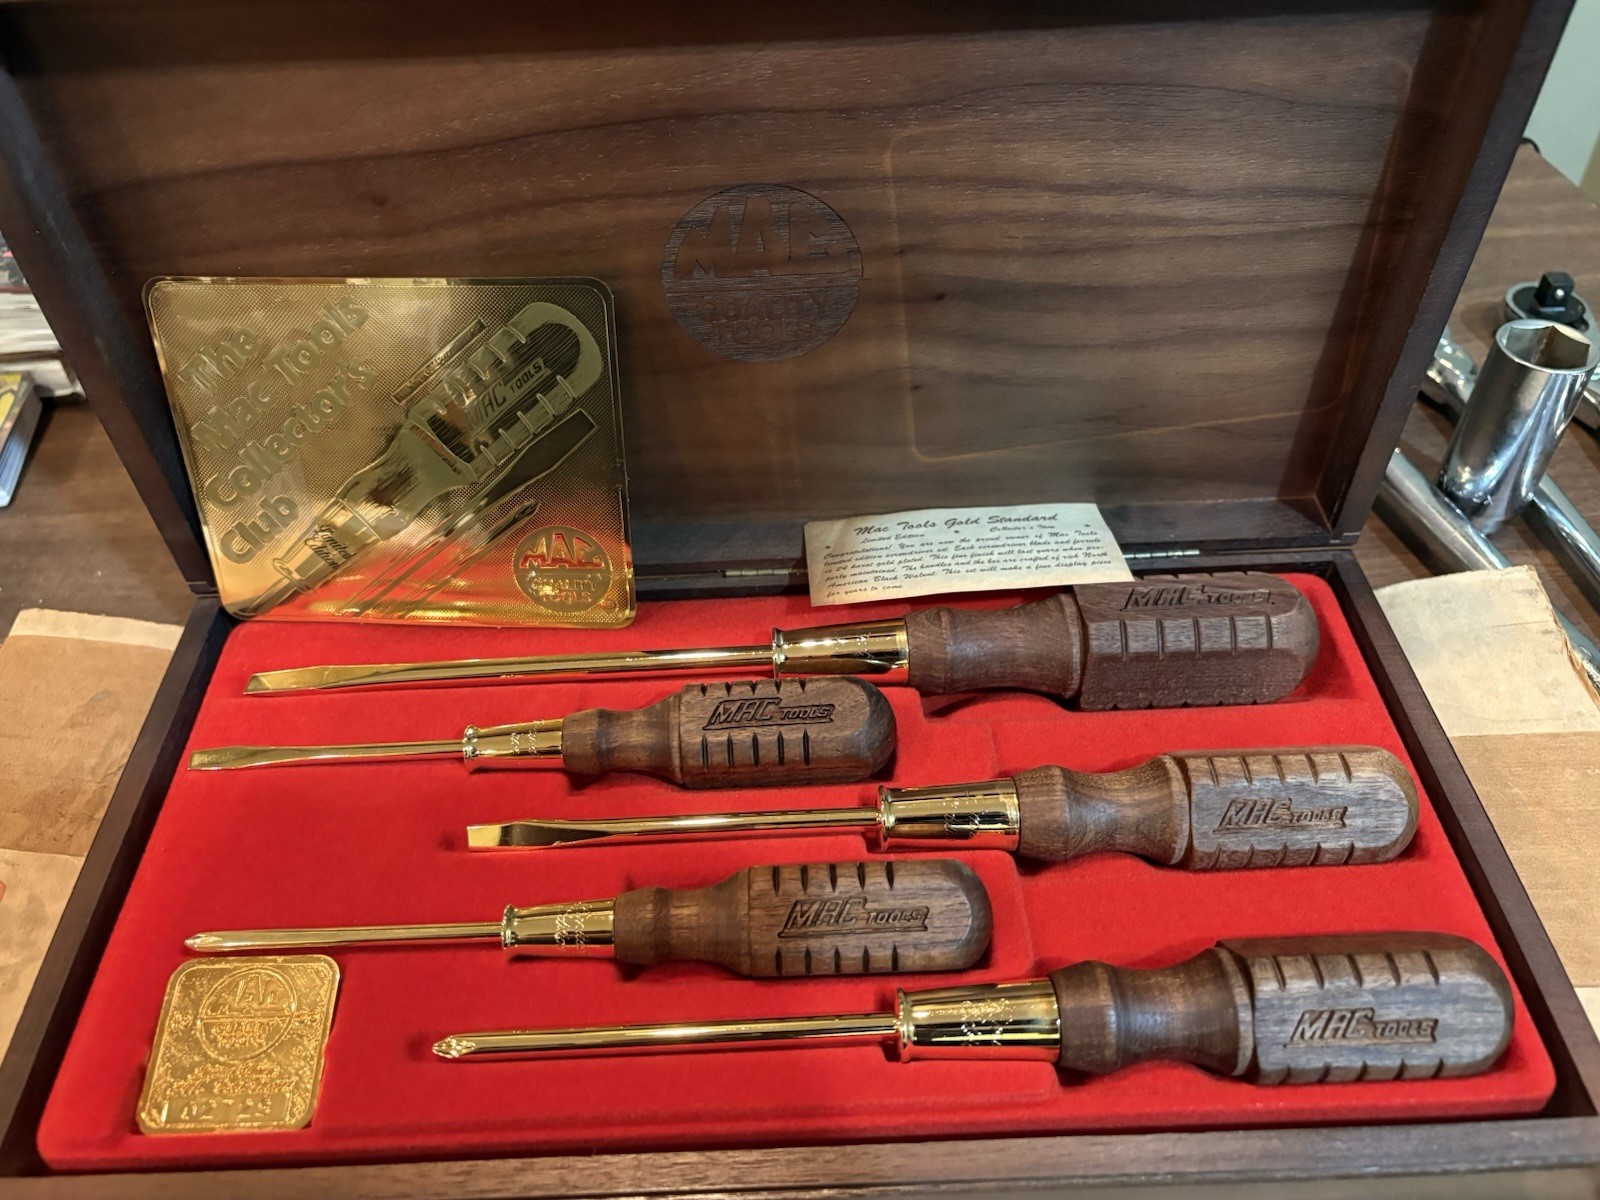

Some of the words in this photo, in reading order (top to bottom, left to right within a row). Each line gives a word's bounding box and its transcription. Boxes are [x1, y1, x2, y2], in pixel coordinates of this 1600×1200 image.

[673, 195, 852, 279] MAC
[178, 326, 260, 396] The
[191, 381, 280, 460] Mac
[262, 295, 370, 387] Tools
[510, 361, 543, 394] TOOLS
[204, 359, 377, 512] Collector's
[220, 495, 300, 565] Club
[854, 525, 890, 535] Mac
[896, 519, 937, 531] Tools
[944, 517, 980, 528] Gold
[987, 513, 1059, 524] Standard
[519, 532, 605, 569] MAC
[711, 699, 782, 723] MAC
[781, 706, 831, 721] TOOLS
[787, 898, 868, 930] MAC
[867, 908, 926, 924] TOOLS
[1292, 1008, 1374, 1043] MAC
